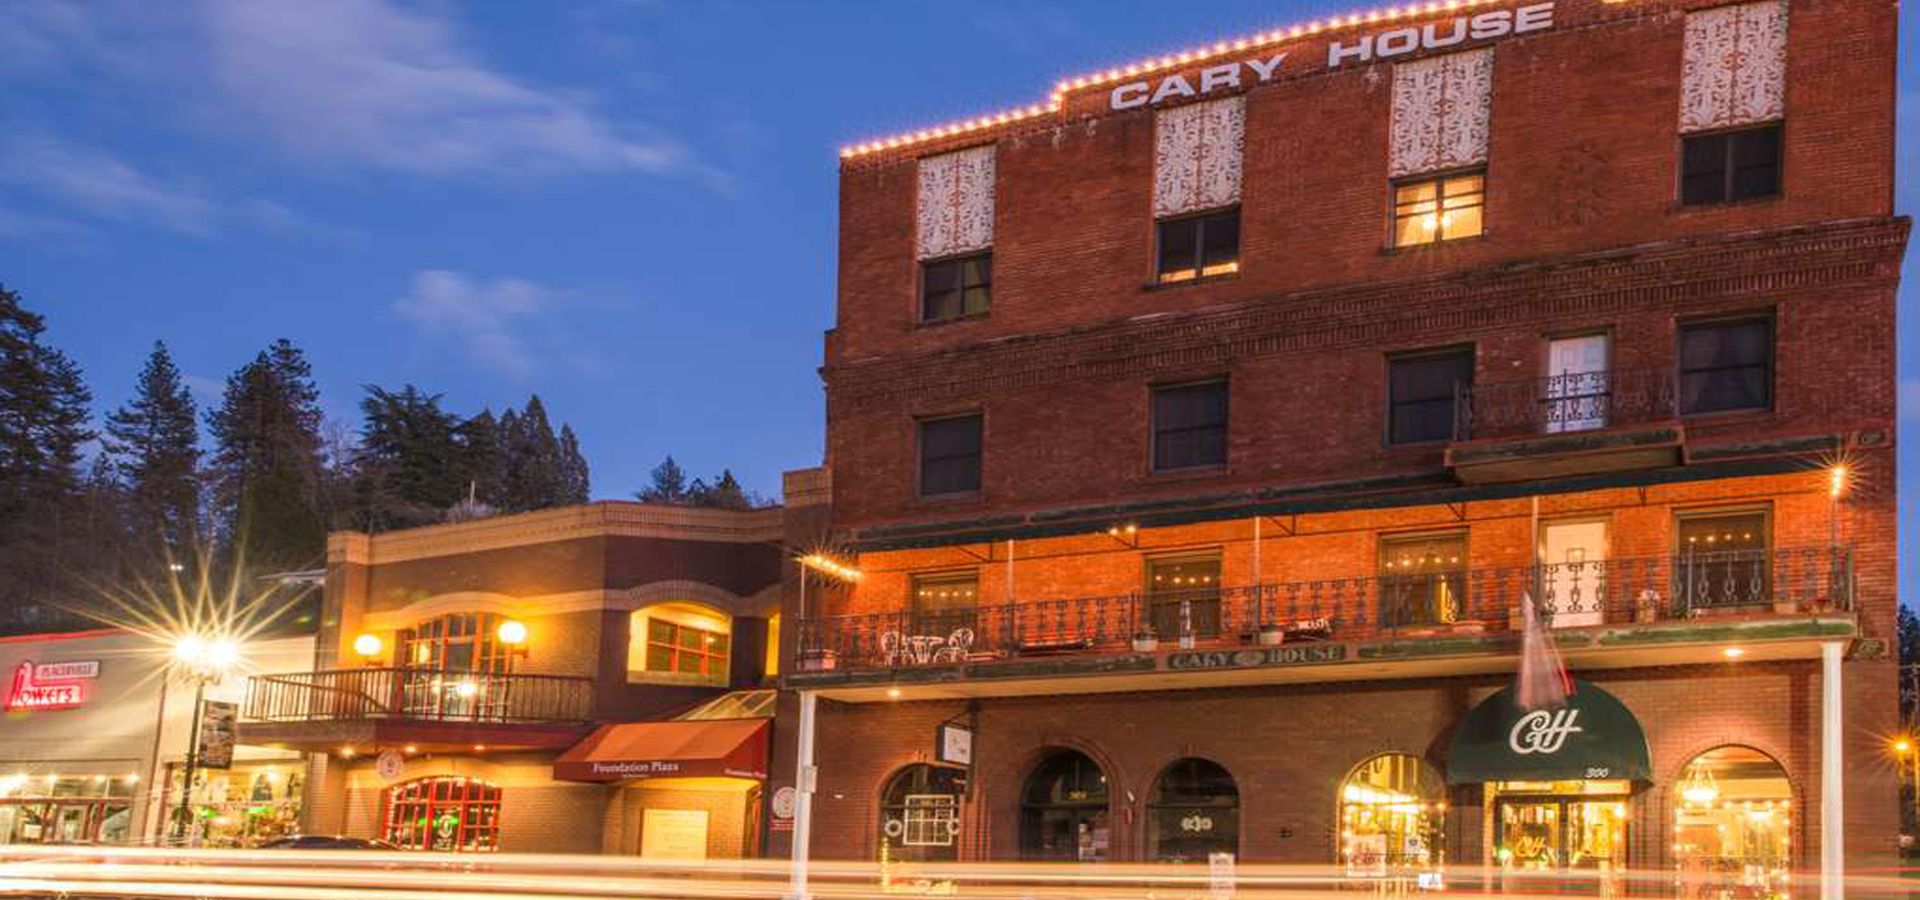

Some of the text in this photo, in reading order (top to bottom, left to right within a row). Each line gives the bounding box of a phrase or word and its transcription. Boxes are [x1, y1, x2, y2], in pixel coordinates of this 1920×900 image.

[1110, 2, 1554, 110] CARY HOUSE
[1172, 646, 1342, 668] CARY HOUSE
[593, 761, 679, 773] Foundation Plaza
[1585, 767, 1609, 778] 300
